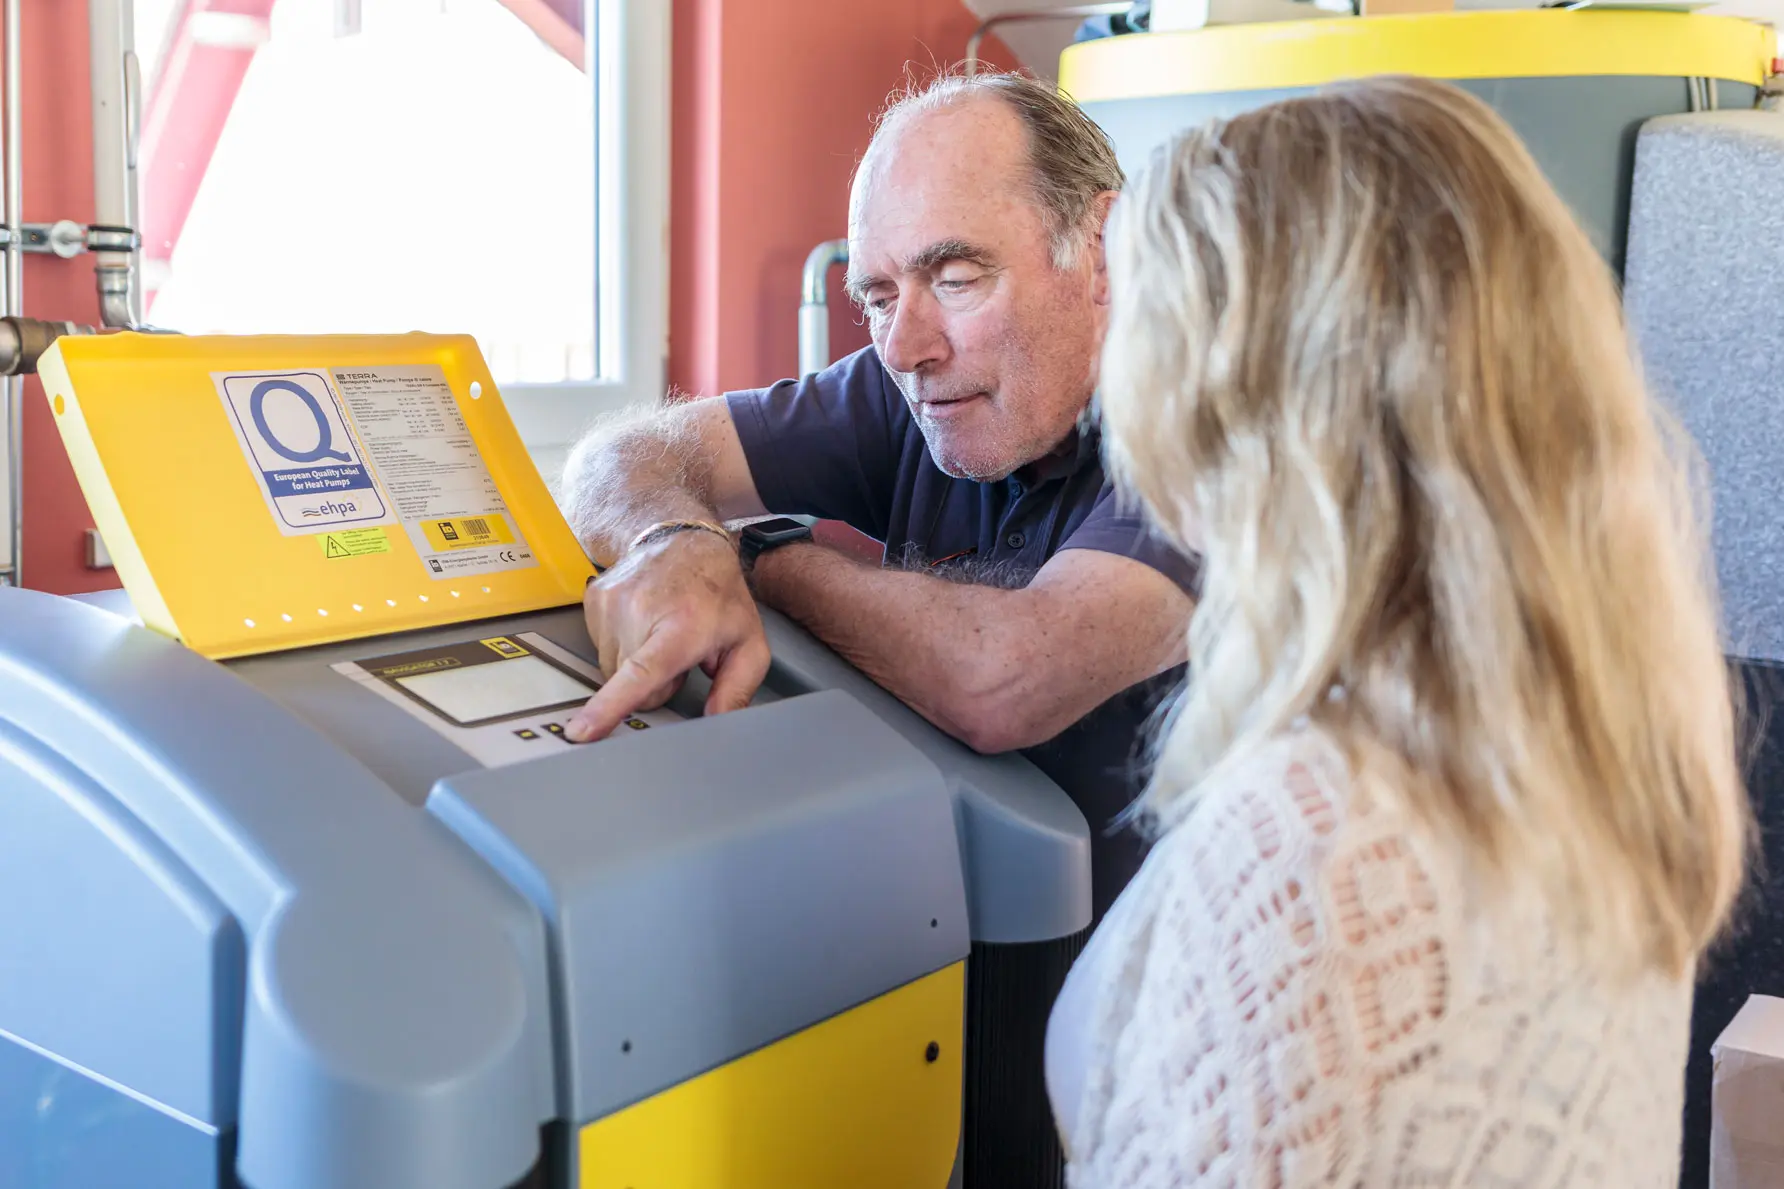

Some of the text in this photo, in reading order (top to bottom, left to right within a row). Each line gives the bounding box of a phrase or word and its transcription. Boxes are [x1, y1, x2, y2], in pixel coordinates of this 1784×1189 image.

[250, 380, 352, 463] Q
[273, 467, 359, 481] European Quality Label
[292, 478, 350, 490] for Heat Pumps
[320, 501, 356, 516] ehpa
